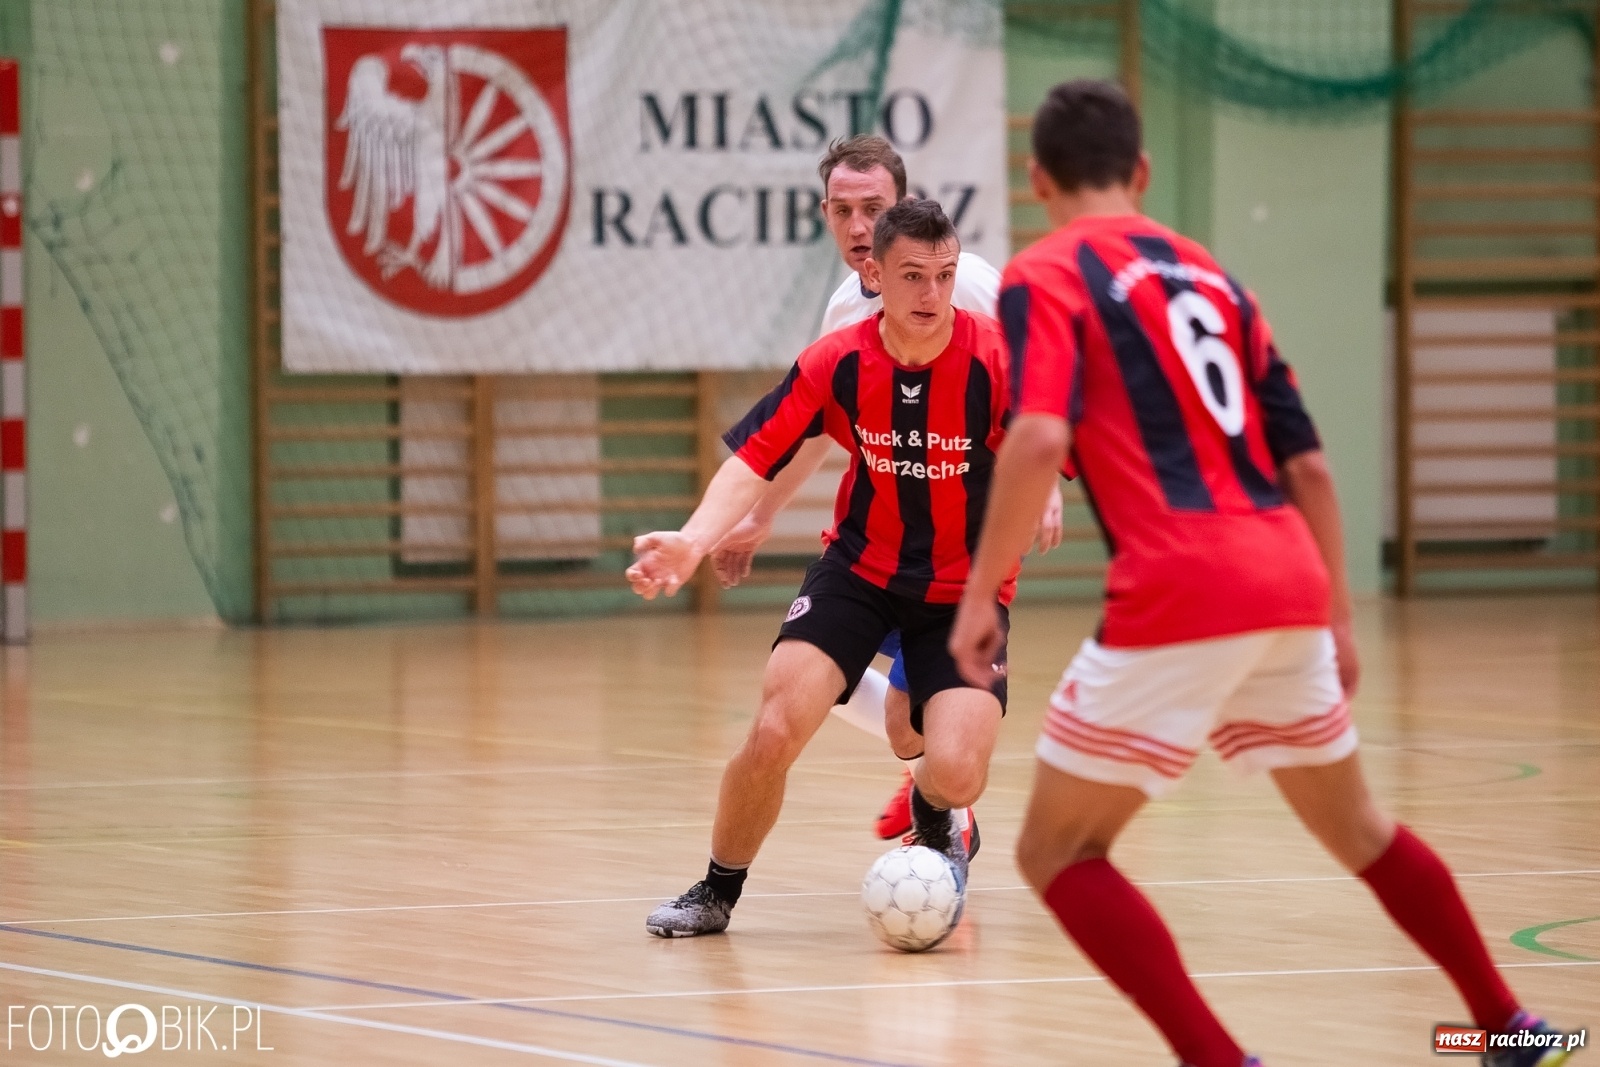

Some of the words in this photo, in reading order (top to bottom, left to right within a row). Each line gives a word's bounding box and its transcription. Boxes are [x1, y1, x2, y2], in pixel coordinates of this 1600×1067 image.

[640, 88, 935, 152] MIASTO
[591, 183, 986, 248] RACIBZ
[1168, 290, 1247, 436] 6
[860, 445, 970, 480] Warzecha
[908, 430, 922, 447] &
[927, 432, 972, 451] Putz
